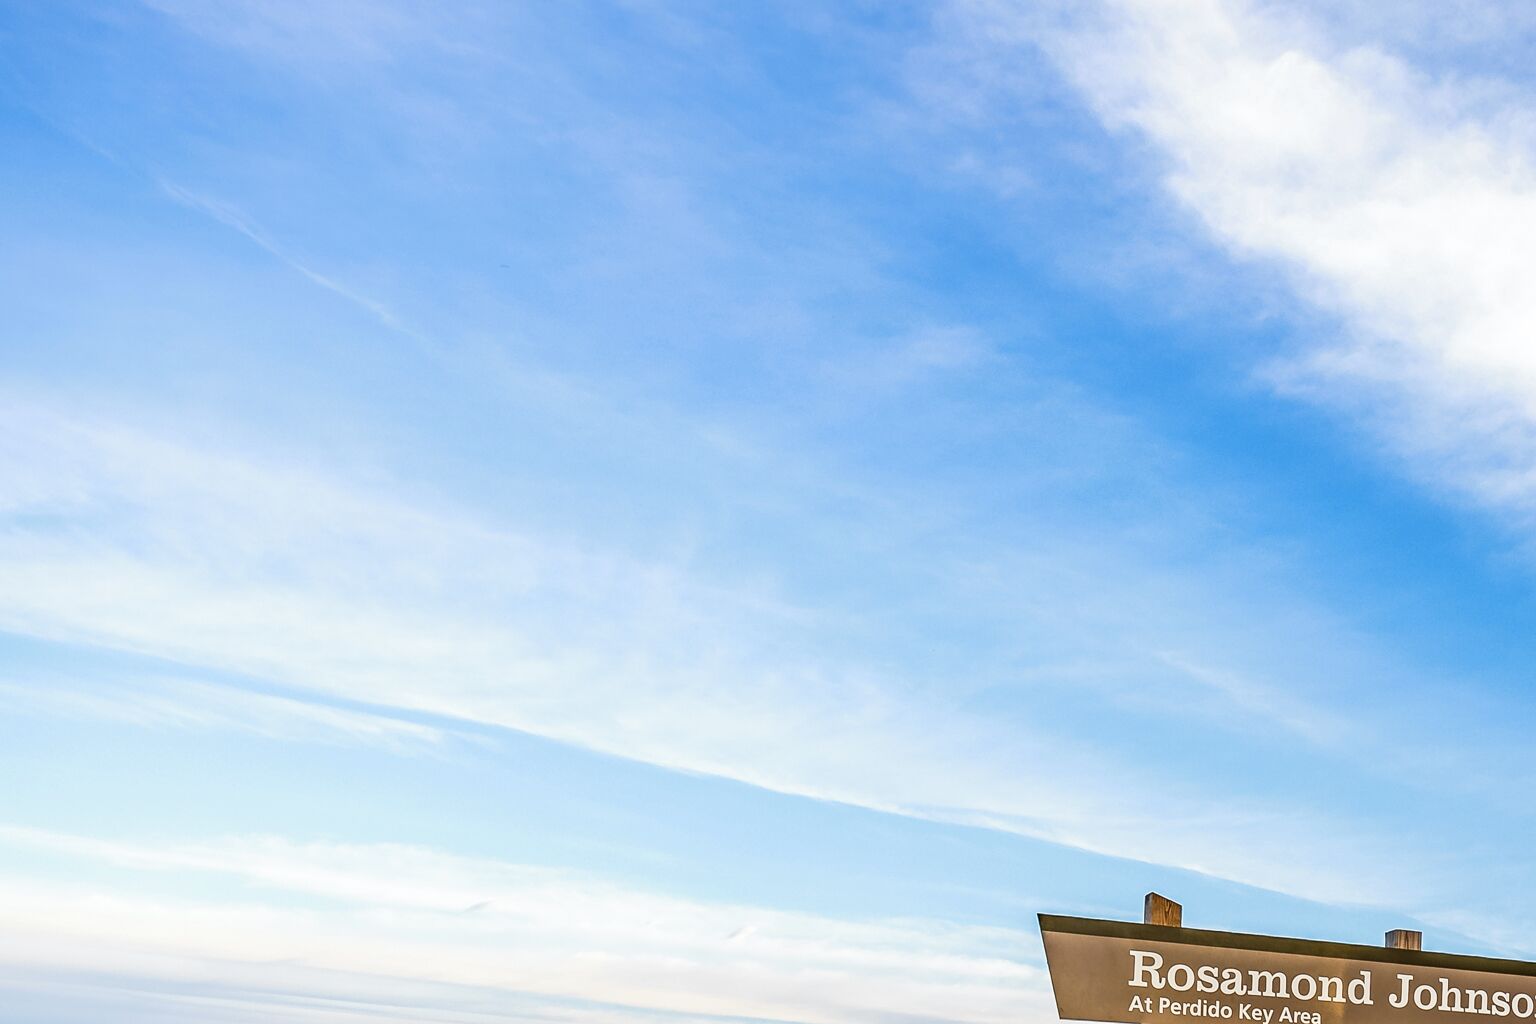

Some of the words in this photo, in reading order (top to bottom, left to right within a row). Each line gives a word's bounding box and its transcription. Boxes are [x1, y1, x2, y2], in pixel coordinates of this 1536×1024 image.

[1128, 950, 1374, 1005] Rosamond
[1128, 995, 1153, 1013] At
[1158, 997, 1233, 1019] Perdido
[1278, 1006, 1321, 1024] Area
